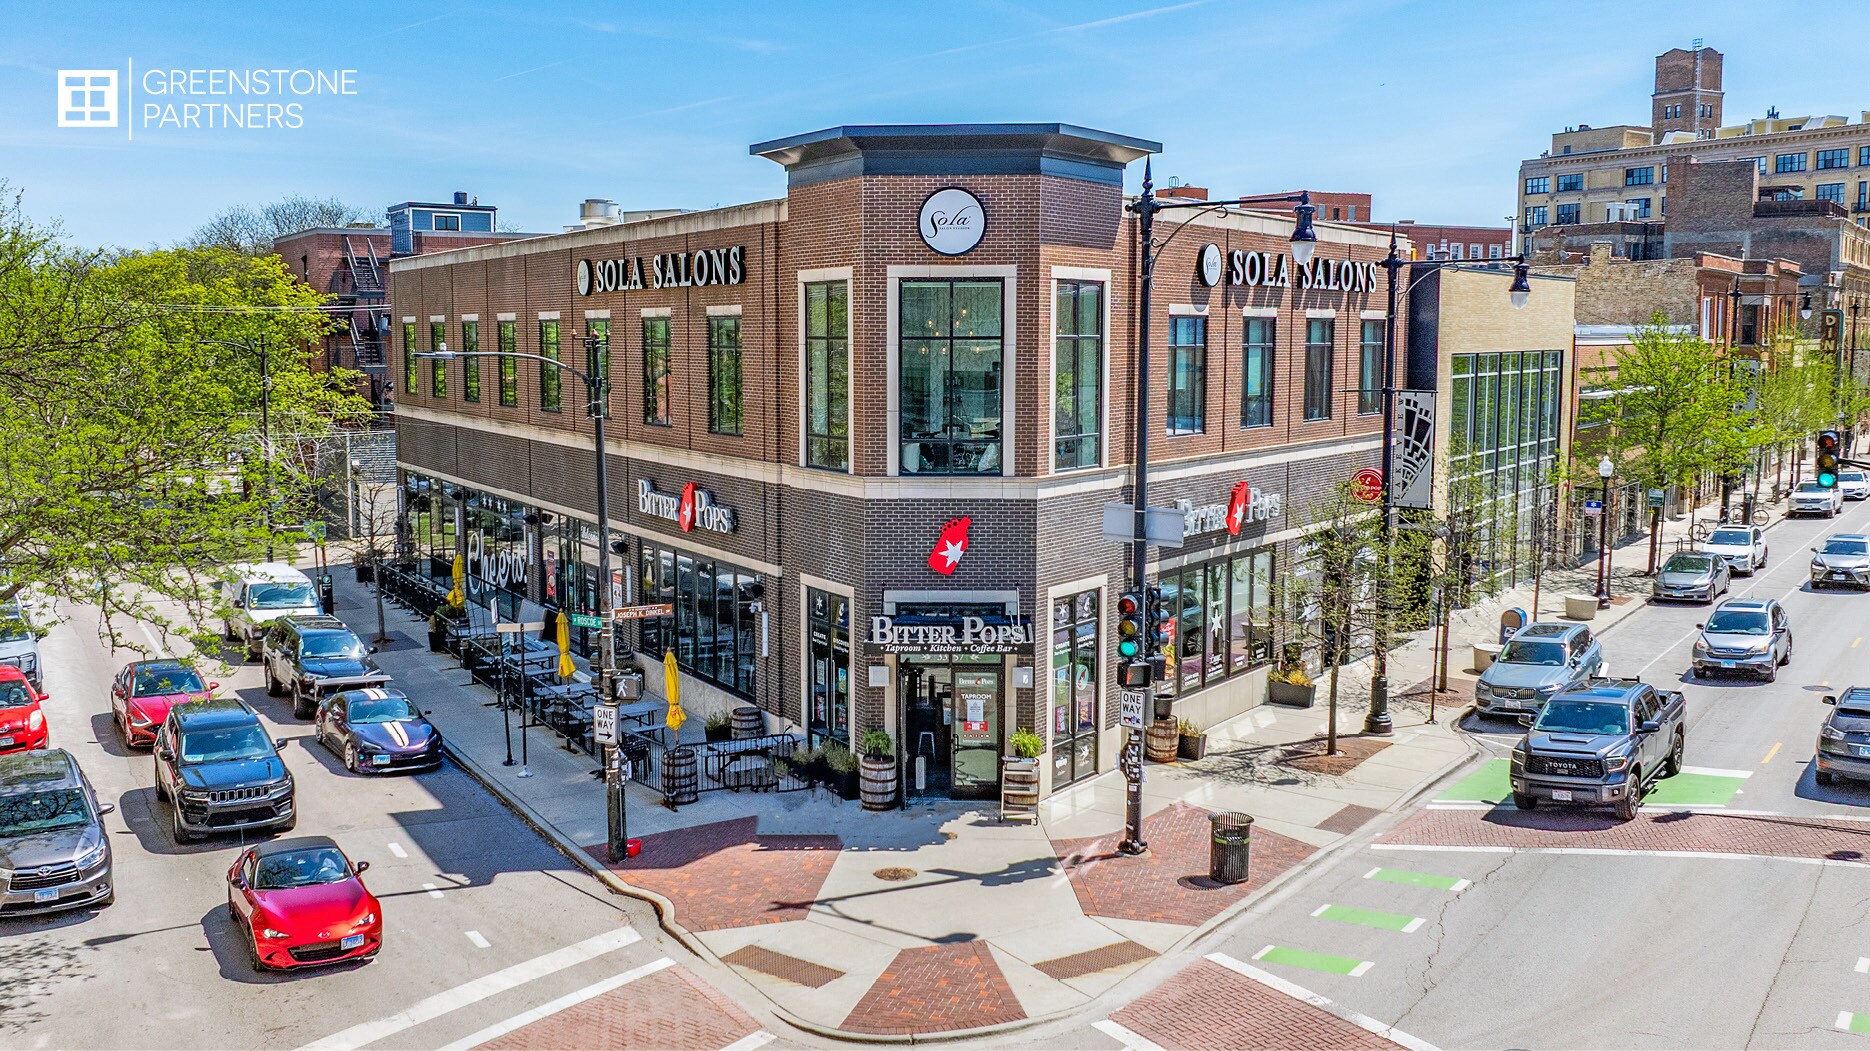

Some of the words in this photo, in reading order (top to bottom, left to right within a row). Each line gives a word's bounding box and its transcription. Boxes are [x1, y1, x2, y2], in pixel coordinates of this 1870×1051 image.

[925, 205, 979, 239] Sola
[596, 256, 643, 293] SOLA
[653, 246, 741, 290] SALONS
[1232, 249, 1291, 288] SOLA
[1302, 257, 1377, 293] SALONS
[1394, 399, 1404, 500] LAKEVIEW
[615, 610, 638, 619] JOSEPH
[645, 608, 664, 616] DINKEL
[577, 616, 597, 627] ROSCOE
[885, 644, 921, 653] Taproom
[929, 644, 962, 652] Kitchen
[970, 644, 995, 654] Coffee
[996, 644, 1013, 652] Bar
[1123, 693, 1141, 705] ONE
[597, 709, 614, 720] ONE
[1122, 703, 1142, 715] WAY
[597, 719, 614, 730] WAY
[1549, 761, 1577, 769] TOYOTA
